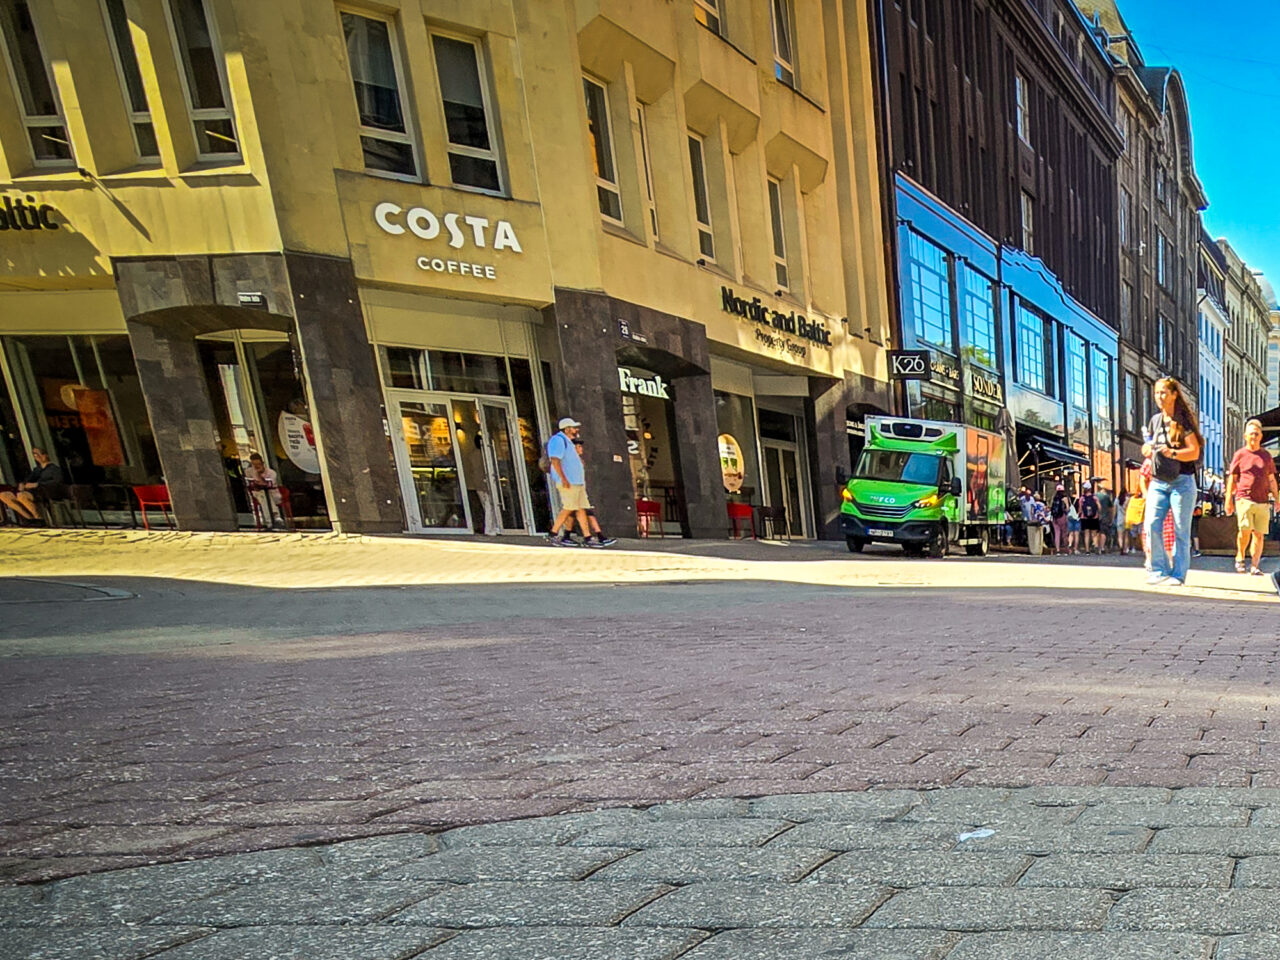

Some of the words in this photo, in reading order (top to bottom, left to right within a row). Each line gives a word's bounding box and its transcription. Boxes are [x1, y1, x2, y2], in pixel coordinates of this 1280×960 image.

[374, 202, 523, 253] COSTA
[417, 256, 497, 280] COFFEE
[721, 285, 770, 325] Nordic
[771, 310, 797, 334] and
[797, 315, 832, 347] Baltic
[755, 328, 785, 351] Property
[785, 338, 807, 358] Group
[891, 355, 925, 374] K26
[617, 367, 670, 400] Frank
